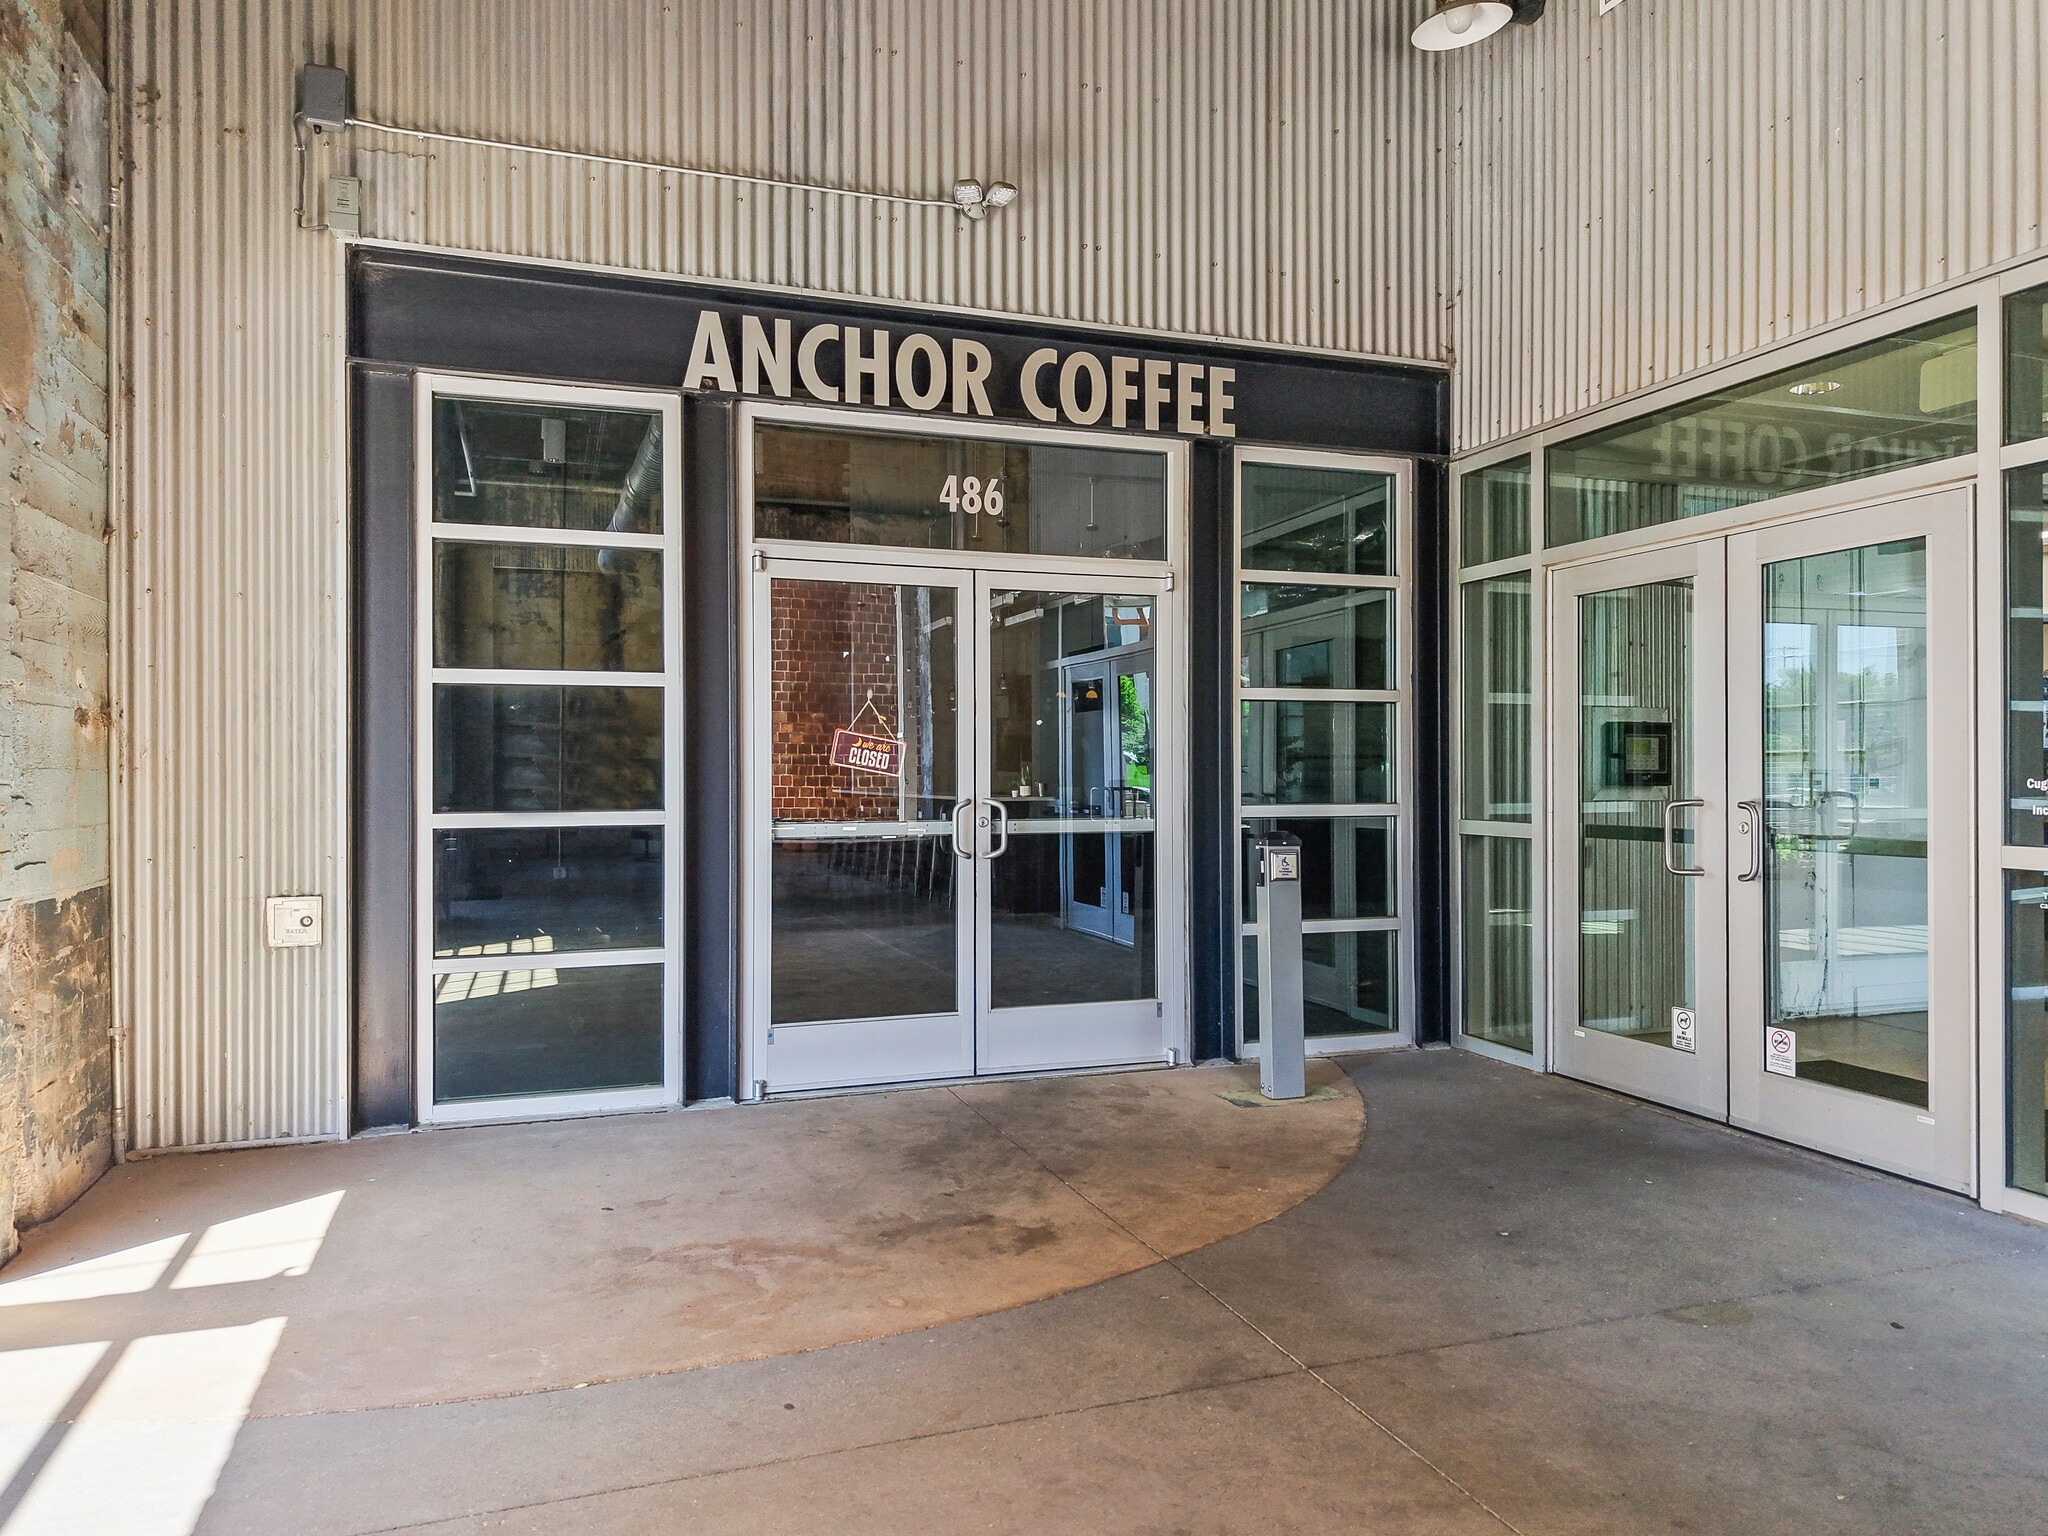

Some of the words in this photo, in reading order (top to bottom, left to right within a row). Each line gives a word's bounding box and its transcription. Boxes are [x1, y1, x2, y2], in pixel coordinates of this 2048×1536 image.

[683, 311, 994, 416] ANCHOR
[1019, 348, 1236, 437] COFFEE
[939, 474, 1004, 516] 486
[848, 747, 890, 769] CLOSED
[862, 741, 874, 749] we
[875, 744, 890, 752] are
